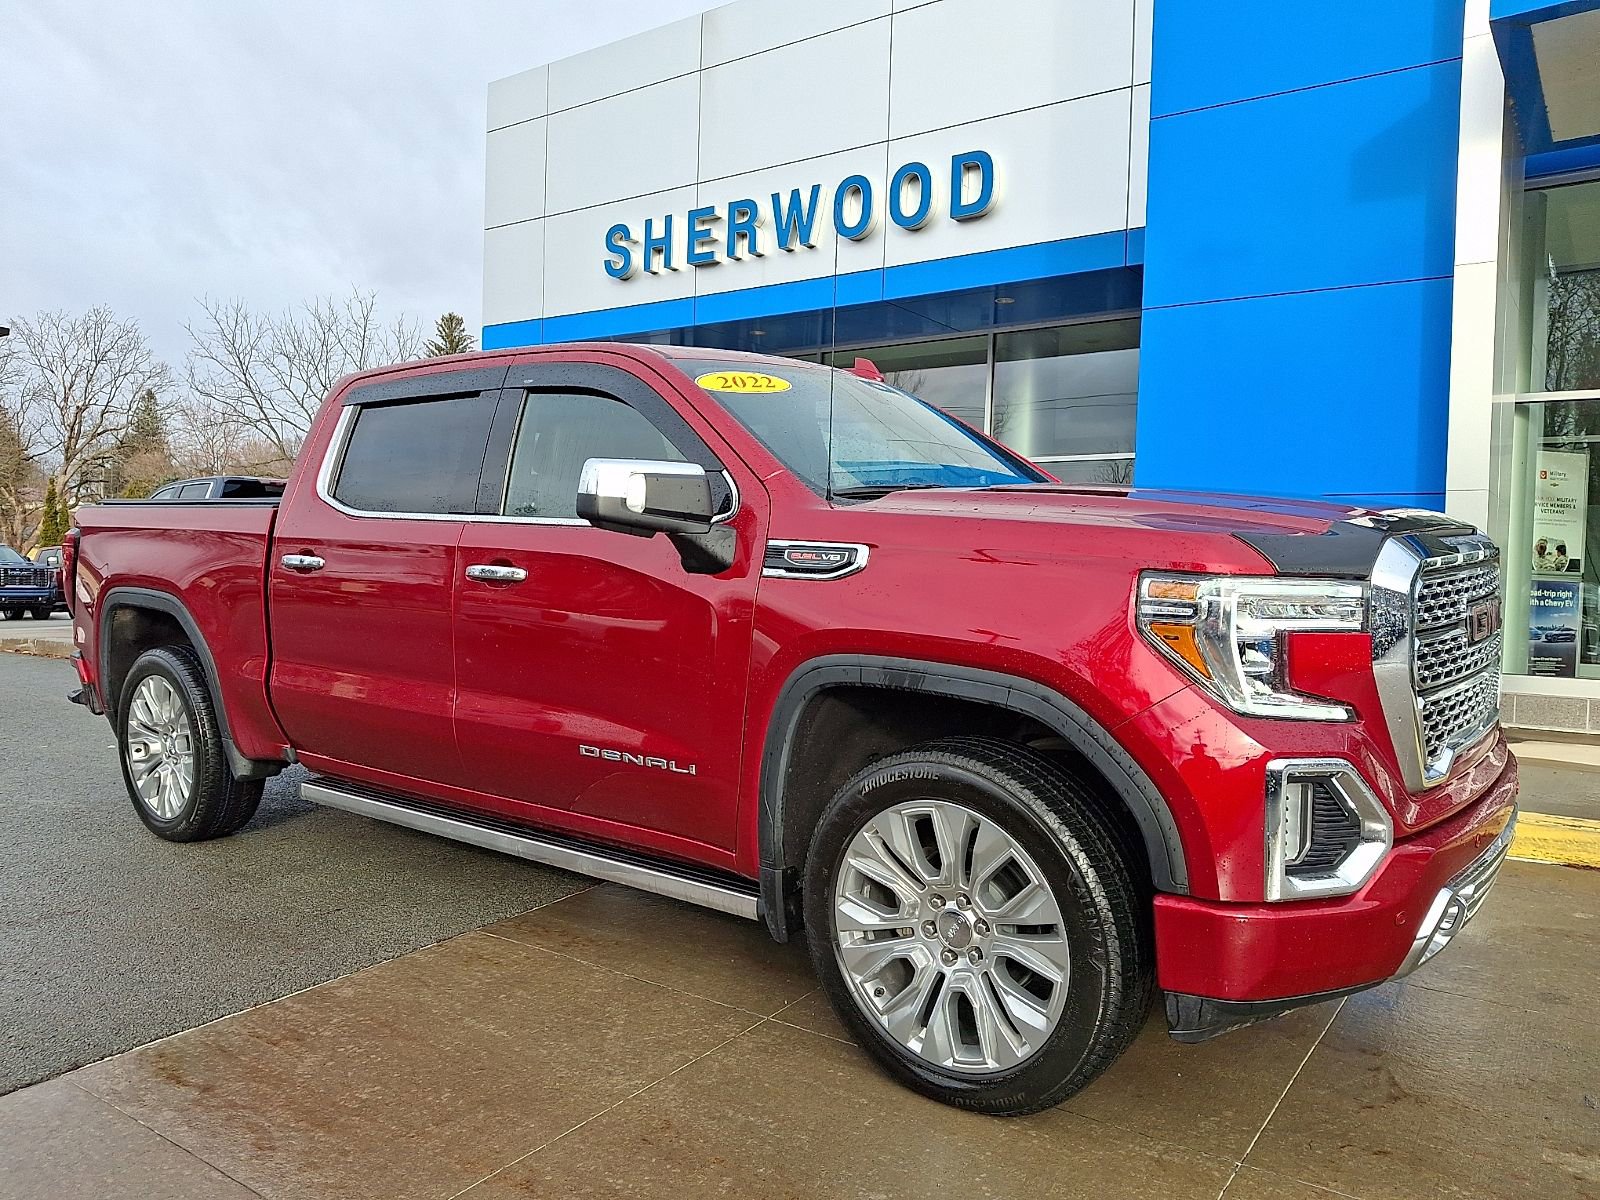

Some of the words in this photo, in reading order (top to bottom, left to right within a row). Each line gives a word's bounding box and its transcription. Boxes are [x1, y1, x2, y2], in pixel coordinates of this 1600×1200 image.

[603, 150, 997, 279] SHERWOOD
[716, 375, 777, 390] 2022
[1545, 599, 1564, 608] Chevy
[1557, 590, 1573, 598] right
[579, 744, 697, 776] DENALI
[860, 767, 940, 797] BRIDGESTONE
